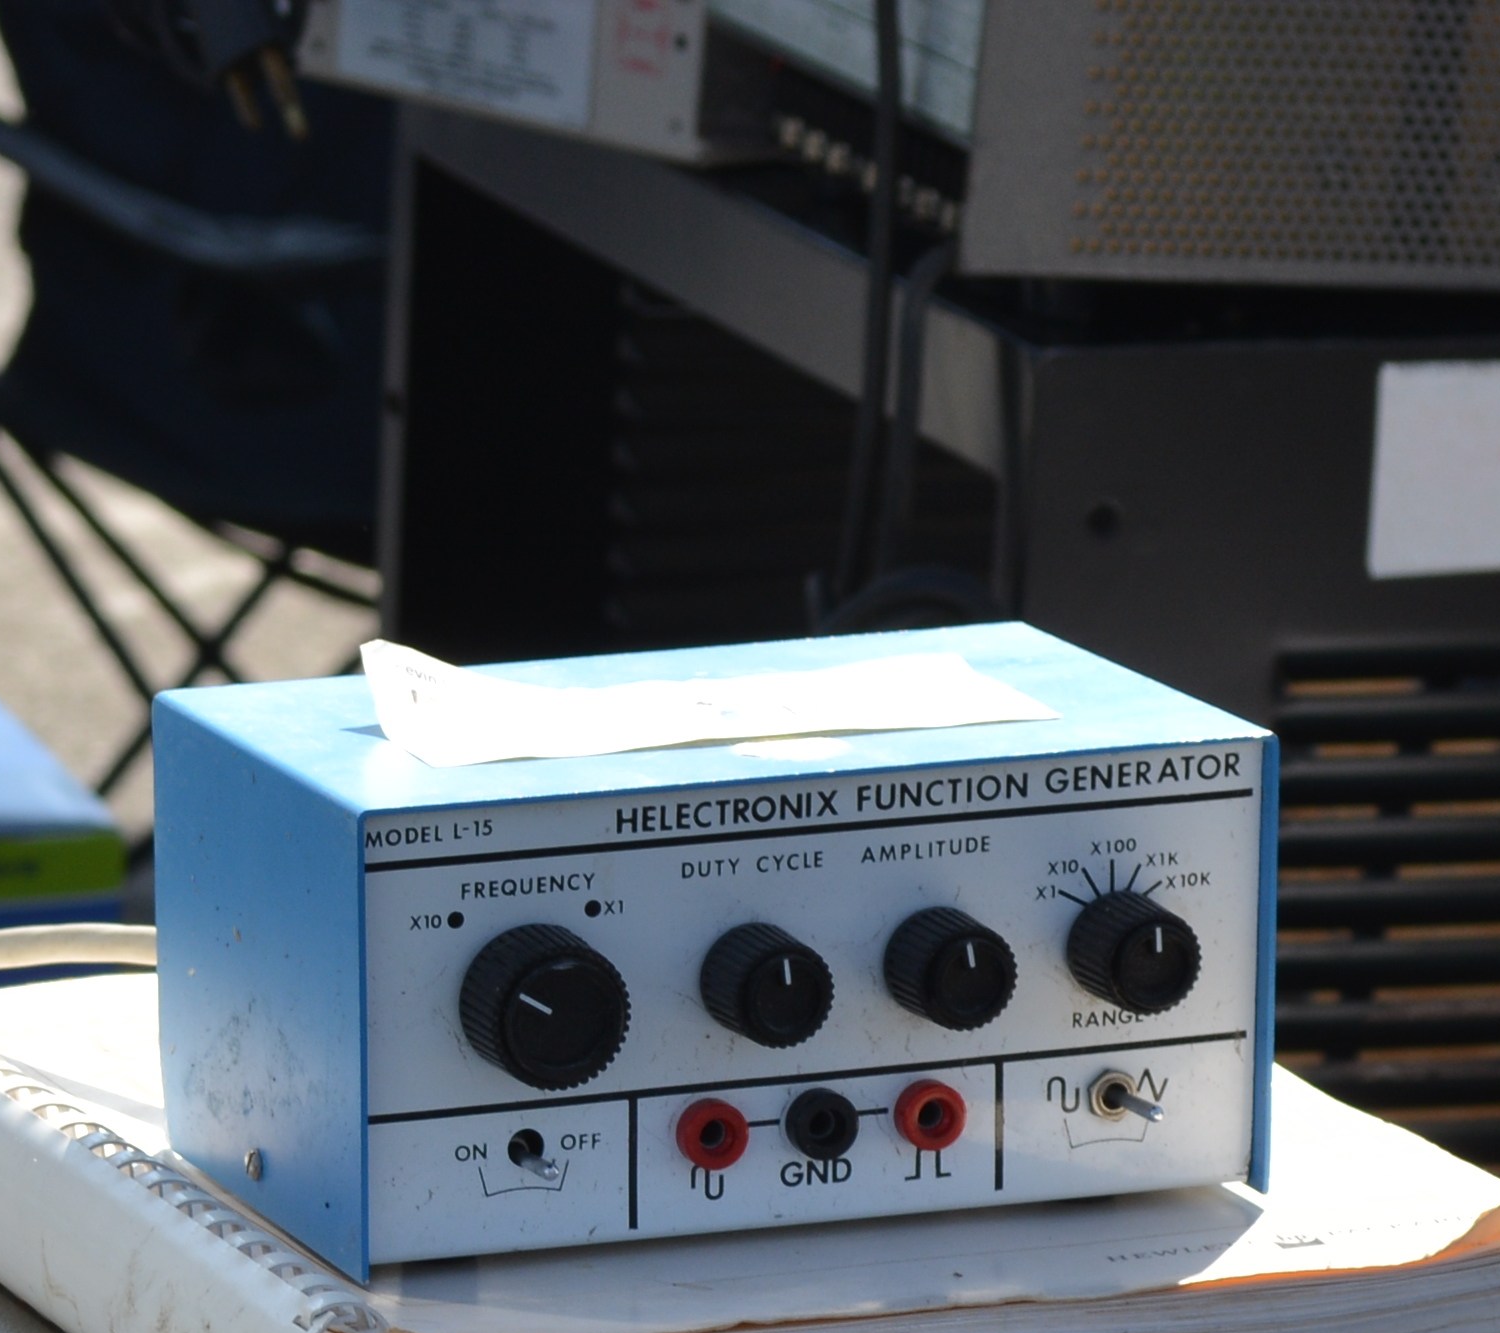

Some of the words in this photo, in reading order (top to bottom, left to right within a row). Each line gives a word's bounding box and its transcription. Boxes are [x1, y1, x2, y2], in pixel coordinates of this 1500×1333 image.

[615, 789, 838, 834] HELECTRONIX
[855, 770, 1029, 812] FUNCTION
[1043, 753, 1242, 796] GENERATOR
[365, 827, 443, 849] MODEL
[451, 819, 494, 842] L-15
[860, 835, 991, 864] AMPLITUDE
[1090, 837, 1137, 856] X100
[680, 858, 740, 878] DUTY
[756, 851, 824, 873] CYCLE
[1047, 859, 1079, 877] X10
[1145, 851, 1178, 868] X1K
[460, 872, 596, 899] FREQUENCY
[1165, 871, 1211, 890] X10K
[409, 912, 442, 931] X10
[1071, 1009, 1145, 1030] RANGE
[454, 1142, 488, 1163] ON
[561, 1132, 603, 1153] OFF
[780, 1157, 851, 1187] GND
